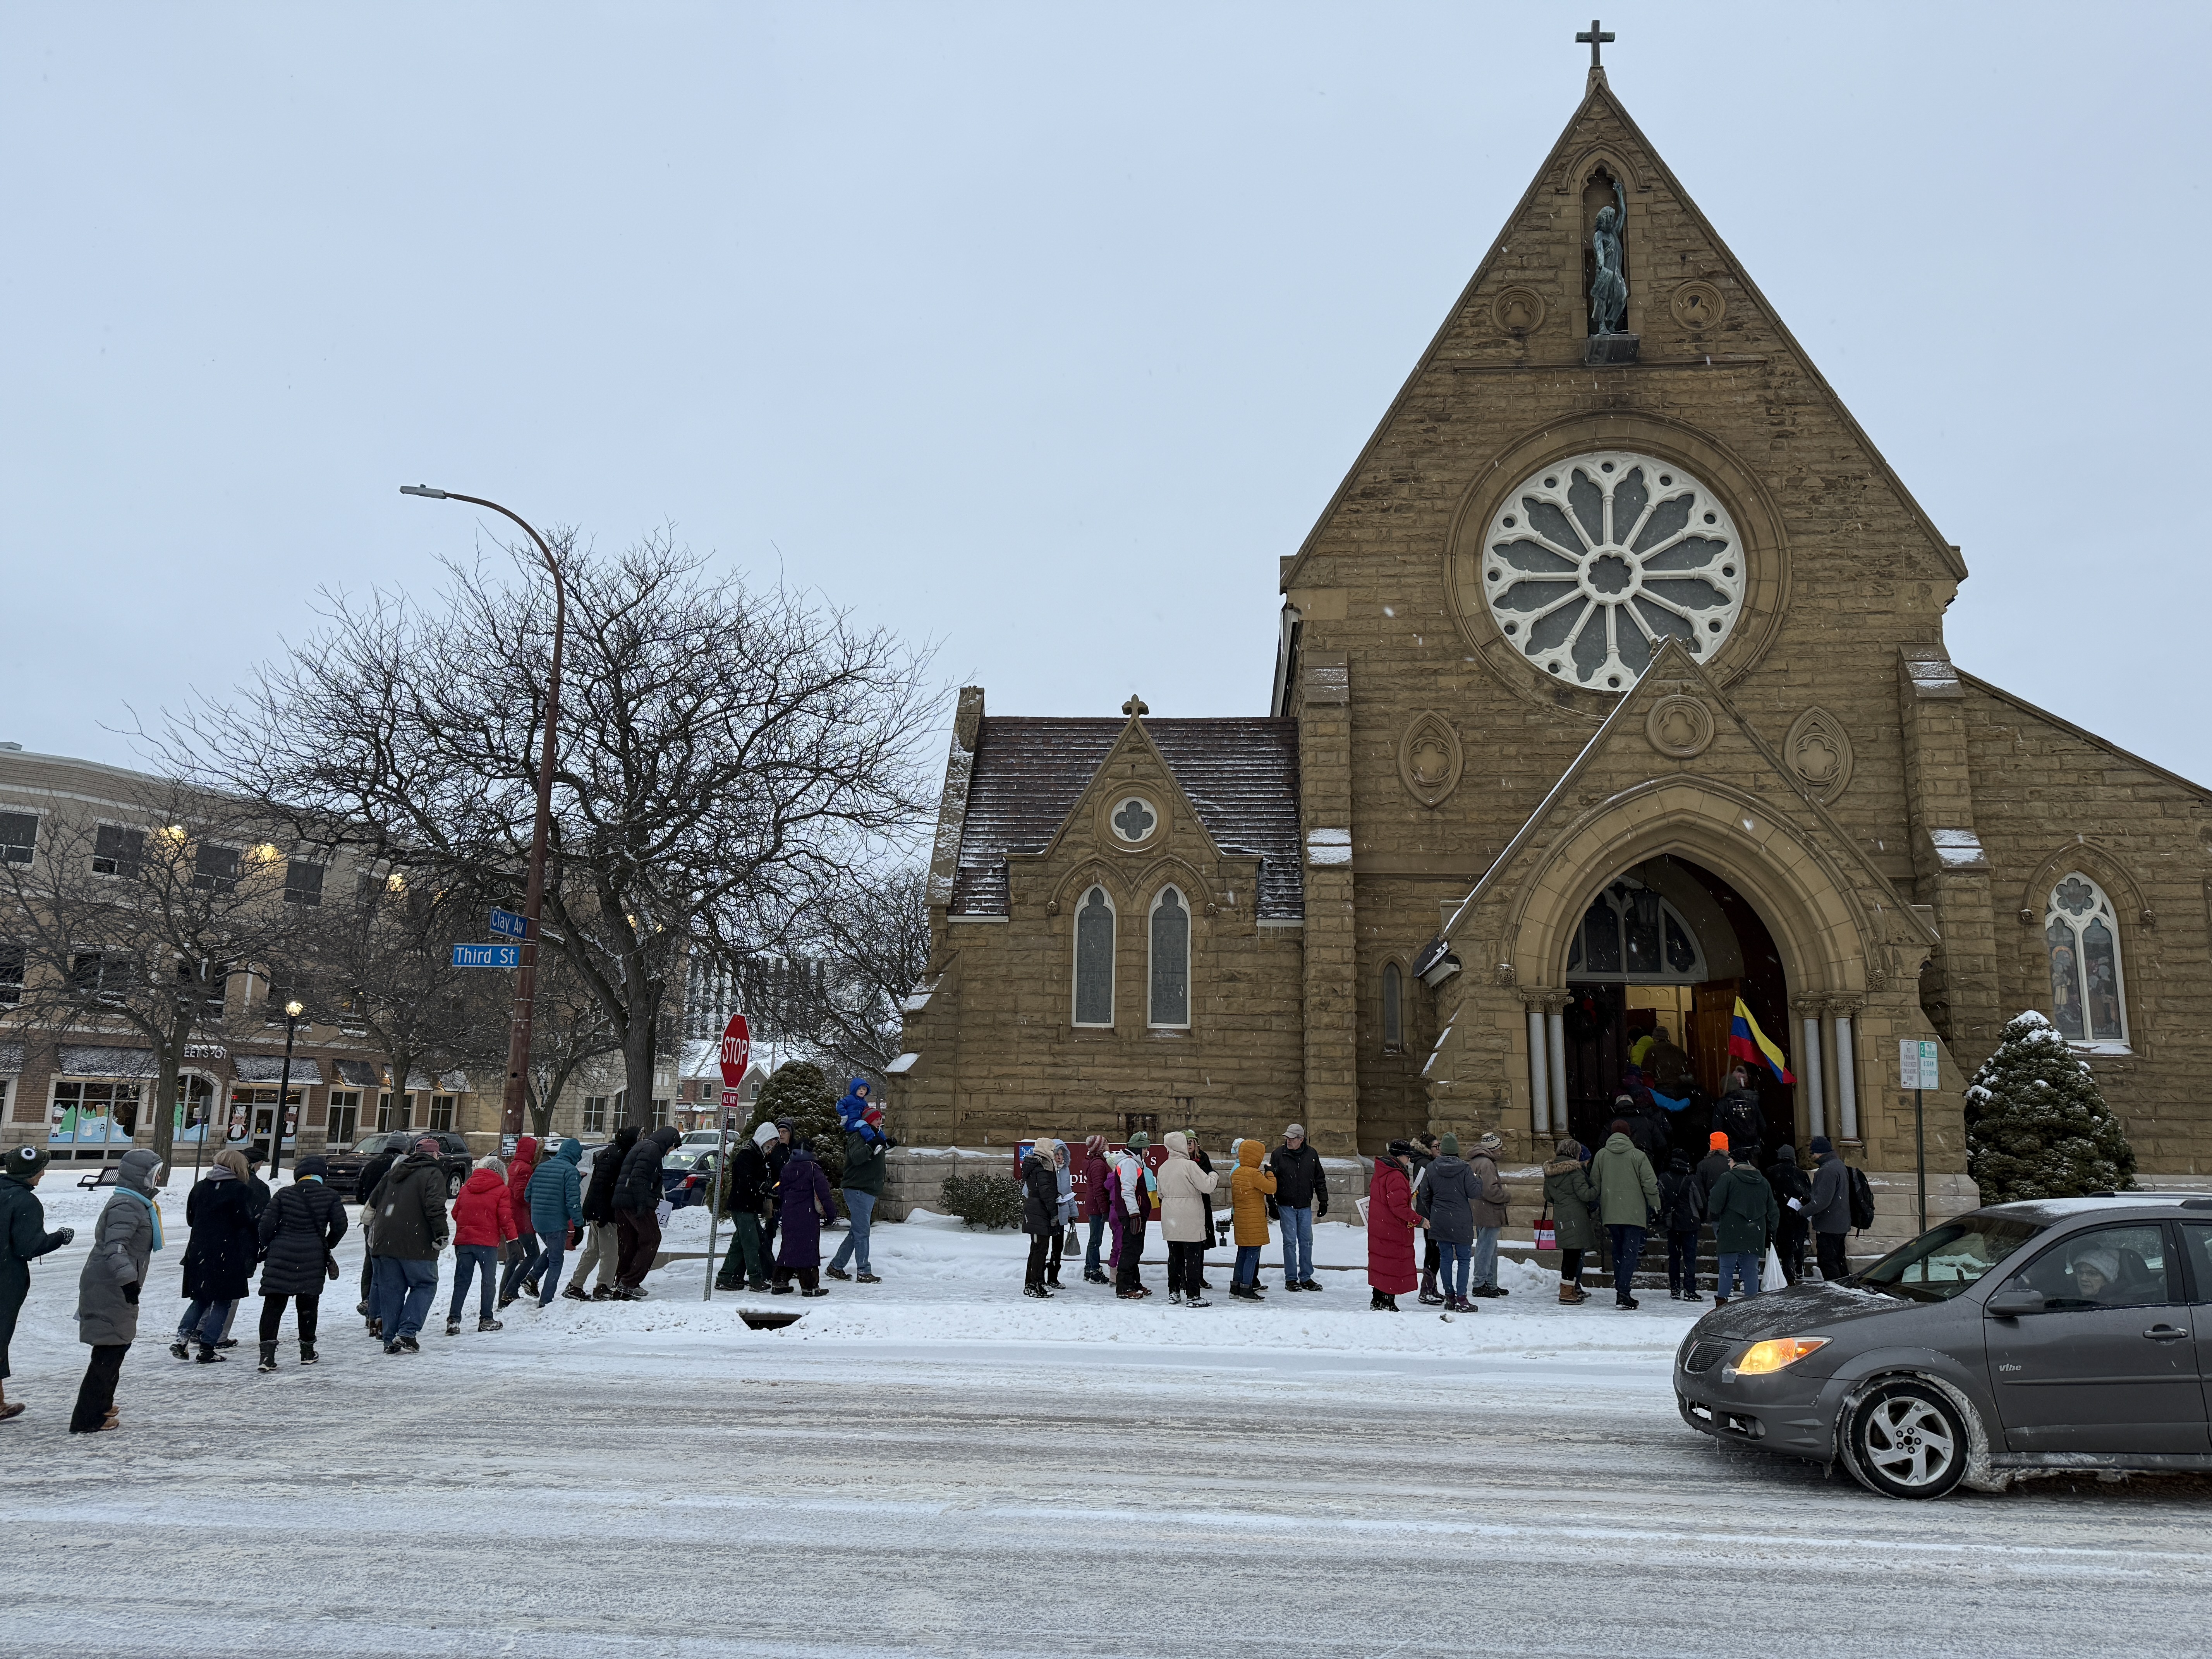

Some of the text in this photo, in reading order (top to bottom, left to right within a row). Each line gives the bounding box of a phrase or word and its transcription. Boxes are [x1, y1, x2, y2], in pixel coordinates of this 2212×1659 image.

[491, 910, 523, 934] Clay Av
[456, 947, 515, 964] Third St
[722, 1036, 747, 1065] STOP
[1921, 1045, 1924, 1054] 2
[1999, 1363, 2022, 1371] vibe
